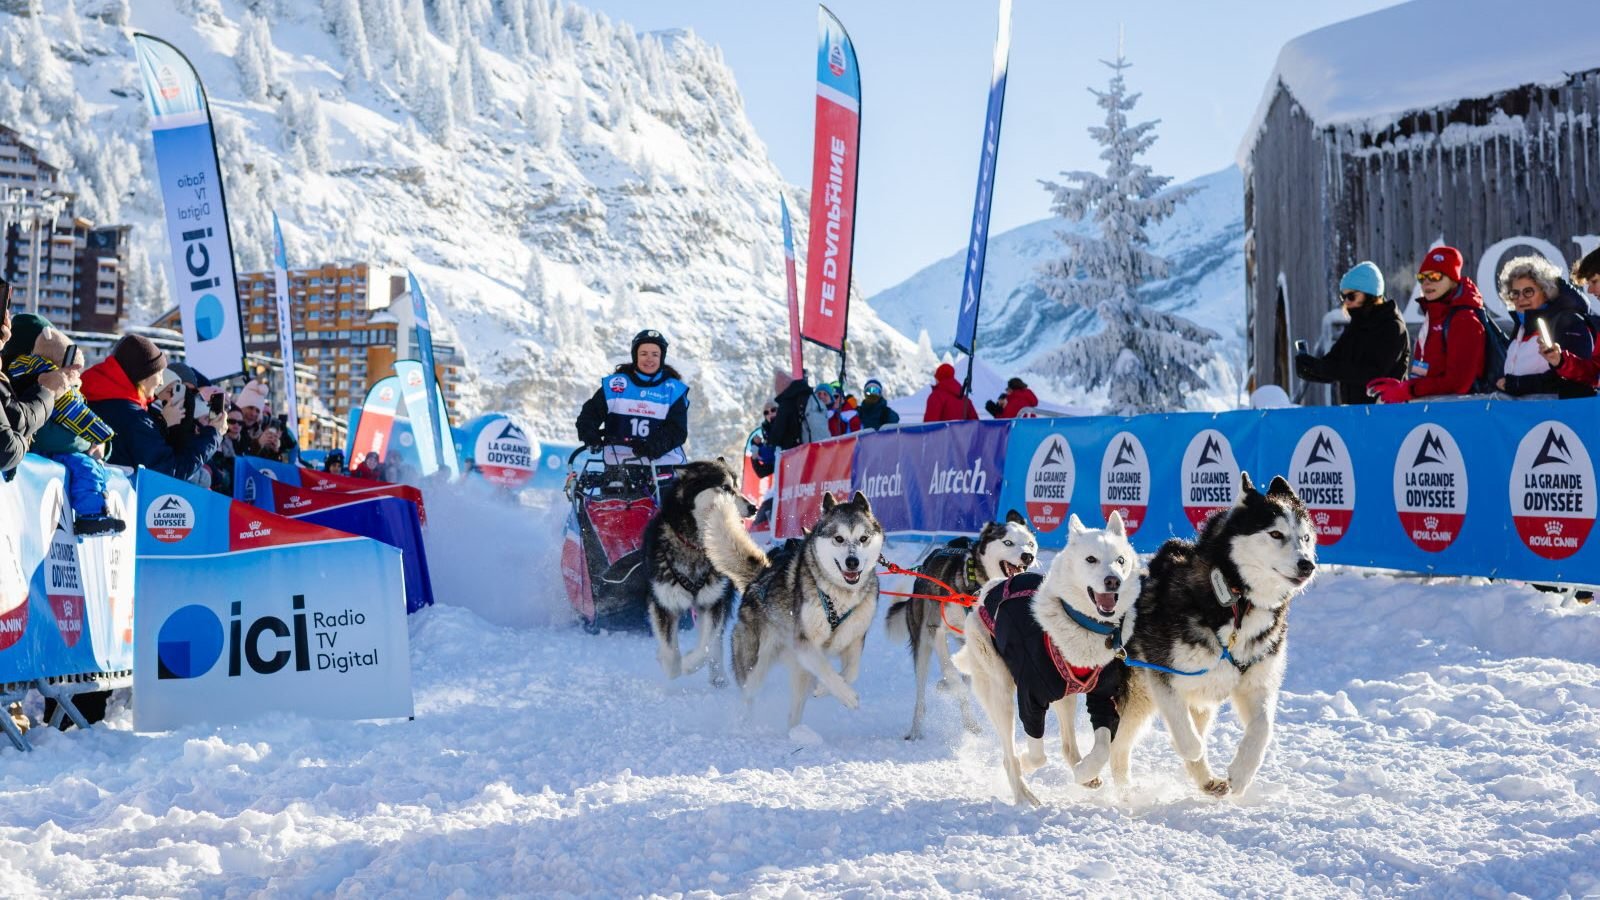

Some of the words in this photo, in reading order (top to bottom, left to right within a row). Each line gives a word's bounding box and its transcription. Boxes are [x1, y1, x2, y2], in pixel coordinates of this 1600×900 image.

[630, 418, 650, 437] 16
[488, 441, 499, 450] LA
[501, 444, 531, 456] GRANDE
[860, 461, 902, 498] Antech
[928, 457, 986, 495] Antech
[1035, 471, 1043, 482] LA
[1043, 471, 1067, 483] GRANDE
[1107, 472, 1115, 483] LA
[1115, 472, 1141, 484] GRANDE
[1191, 472, 1200, 484] LA
[1200, 472, 1230, 485] GRANDE
[1298, 472, 1309, 484] LA
[1310, 472, 1343, 485] GRANDE
[1405, 472, 1417, 487] LA
[1418, 473, 1455, 487] GRANDE
[1525, 473, 1538, 489] LA
[1539, 474, 1582, 489] GRANDE
[1412, 530, 1431, 540] ROYAL
[1529, 536, 1552, 547] ROYAL
[1554, 537, 1577, 548] CANIN
[0, 618, 23, 633] ANIN
[313, 609, 366, 628] Radio
[229, 594, 310, 677] ici
[316, 631, 337, 649] TV
[317, 649, 379, 673] Digital
